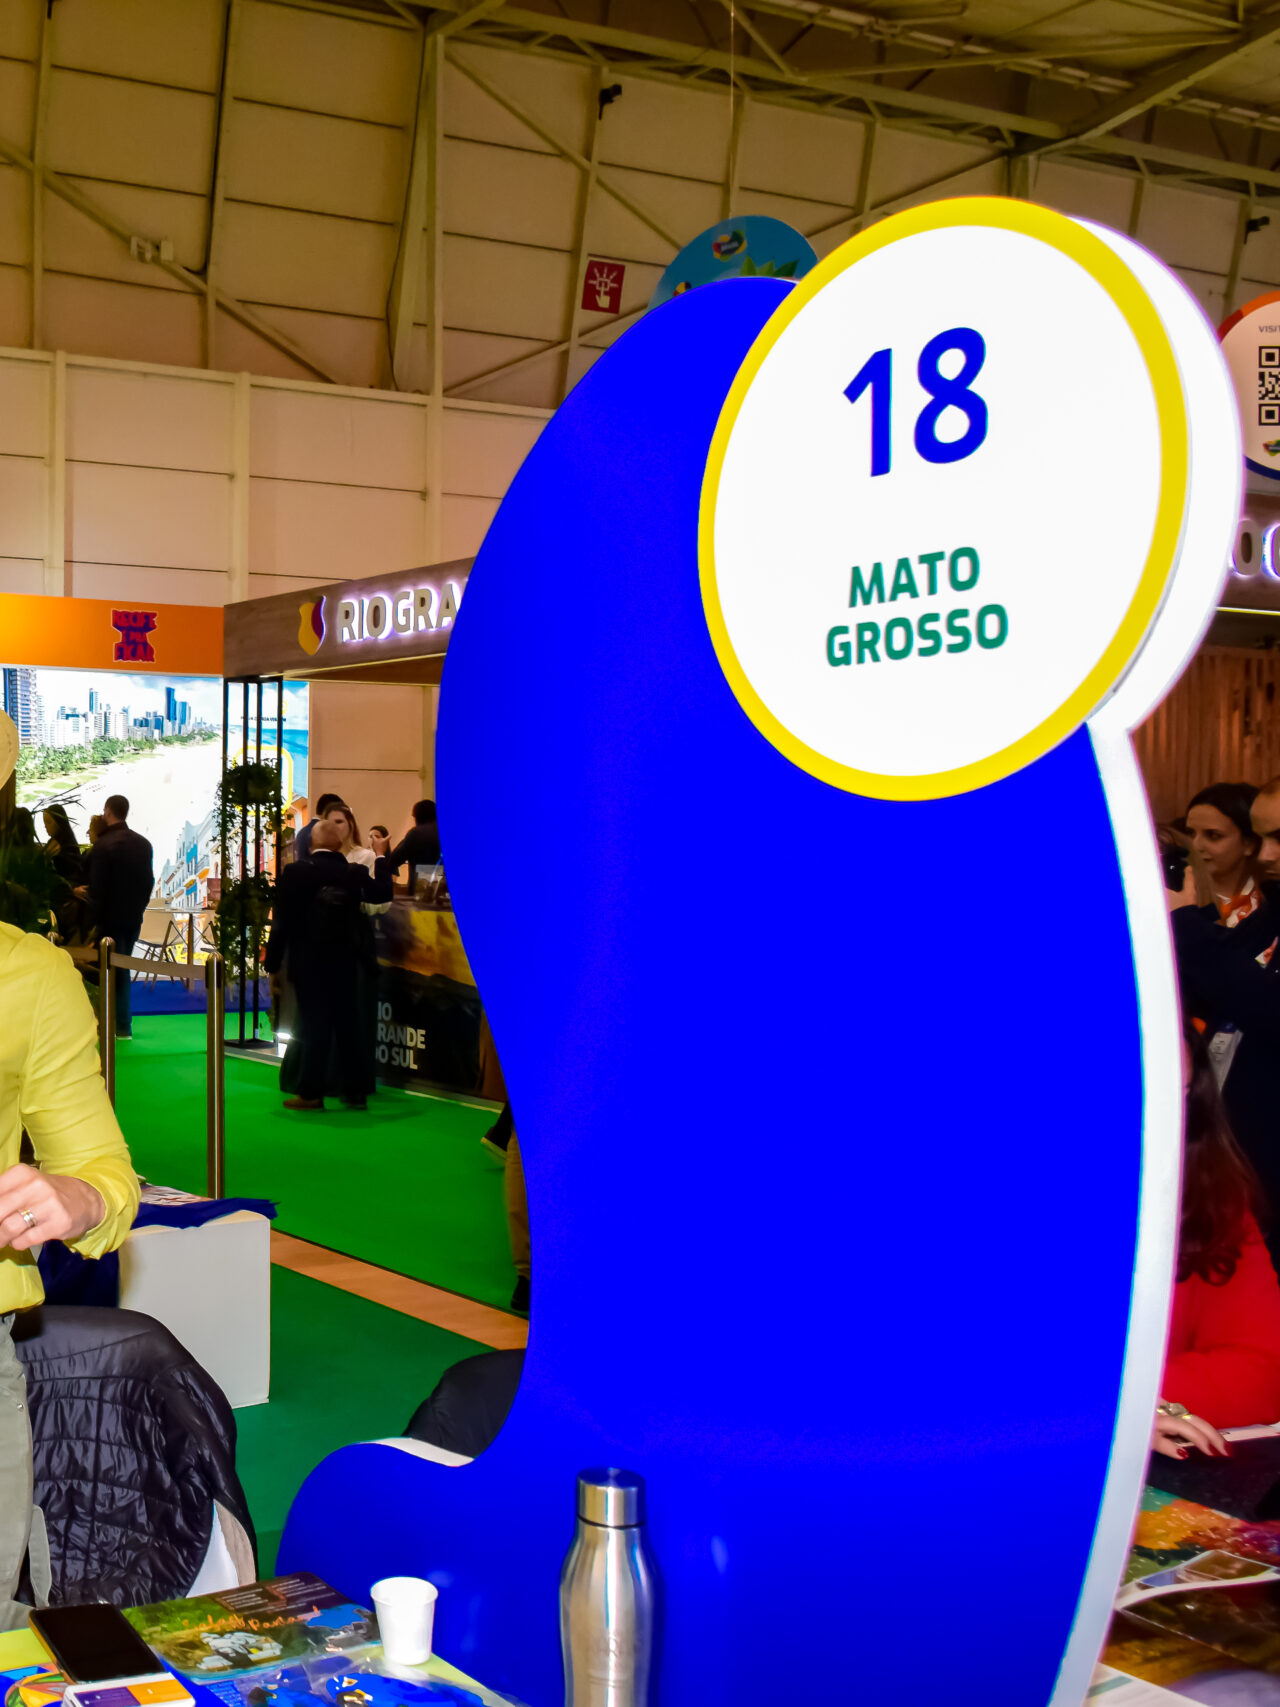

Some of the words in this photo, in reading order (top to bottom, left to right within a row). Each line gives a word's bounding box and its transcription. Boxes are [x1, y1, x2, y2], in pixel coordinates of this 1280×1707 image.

[843, 327, 988, 477] 18
[848, 547, 980, 608] MATO
[393, 581, 466, 634] GRA
[826, 604, 1008, 667] GROSSO
[377, 1001, 392, 1021] IO
[377, 1022, 426, 1049] RANDE
[391, 1047, 418, 1070] SUL
